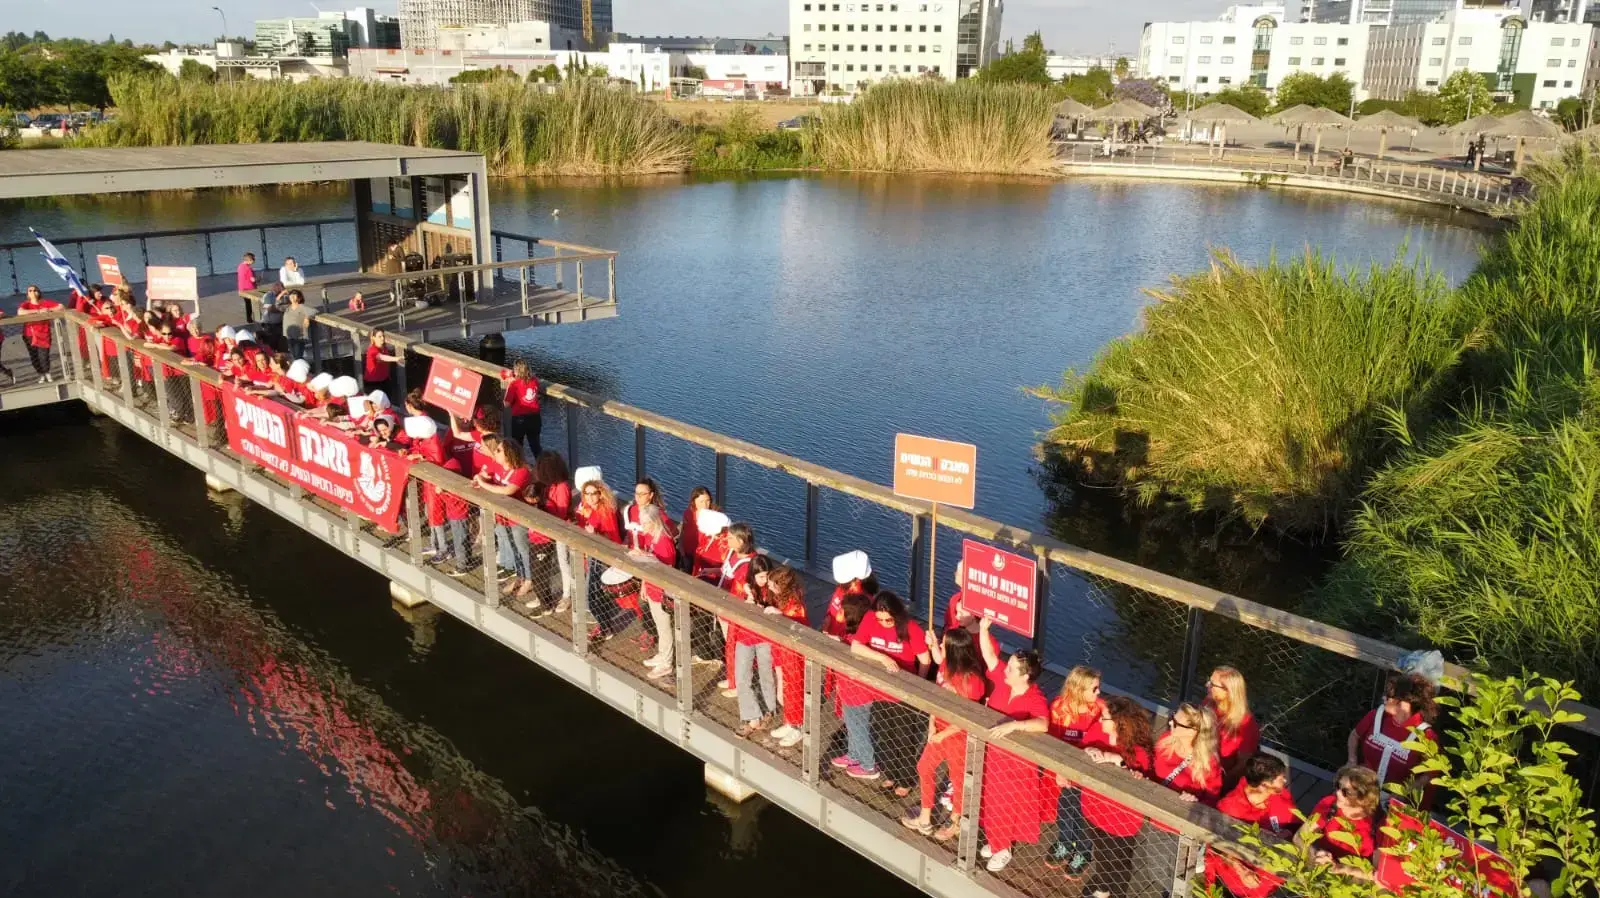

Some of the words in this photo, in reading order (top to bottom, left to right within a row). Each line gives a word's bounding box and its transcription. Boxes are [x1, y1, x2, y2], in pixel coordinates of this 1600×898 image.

[298, 425, 351, 477] מאבק
[900, 452, 932, 468] הנשים
[940, 458, 970, 475] מאבק
[968, 567, 988, 583] אדום
[989, 573, 998, 588] קו
